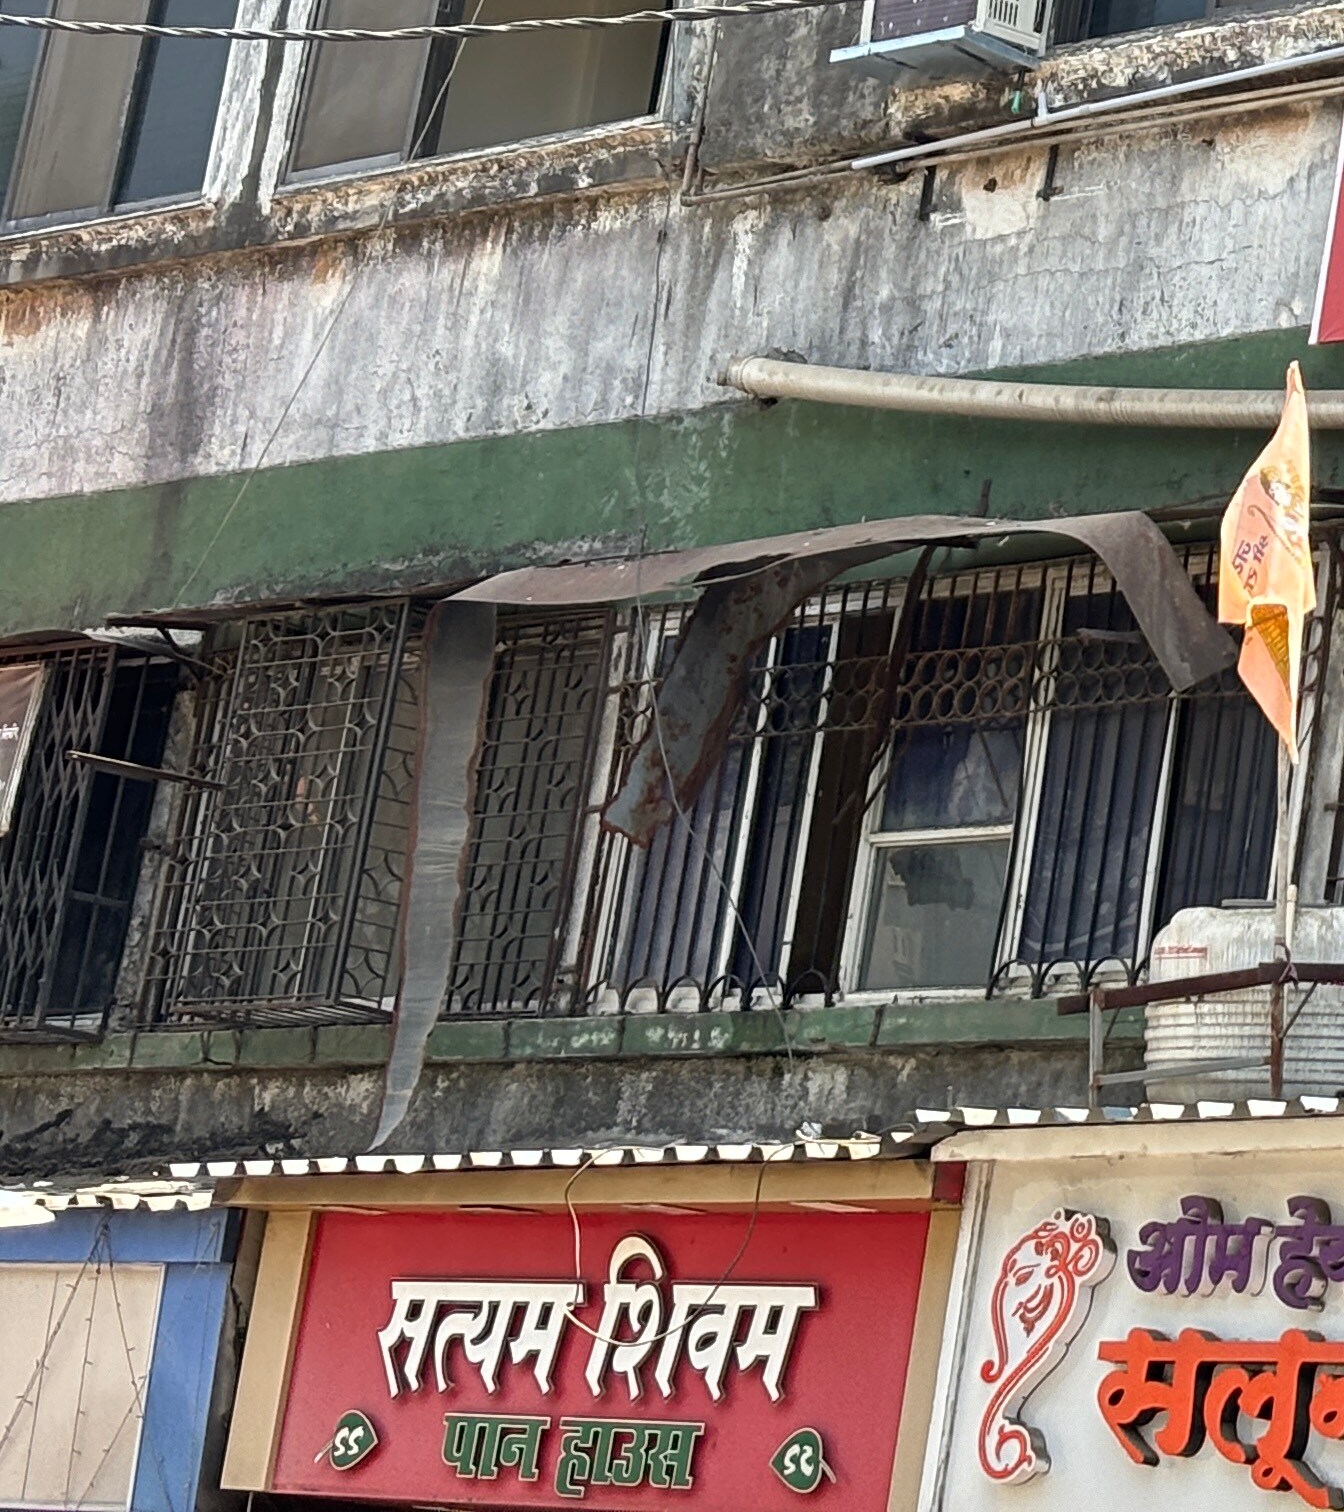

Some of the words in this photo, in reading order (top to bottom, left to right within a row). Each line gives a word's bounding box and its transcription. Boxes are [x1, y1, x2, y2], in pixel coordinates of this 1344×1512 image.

[377, 1278, 586, 1400] सत्यम
[585, 1231, 820, 1404] शिवम
[441, 1412, 551, 1481] पान
[554, 1416, 705, 1499] हाउस
